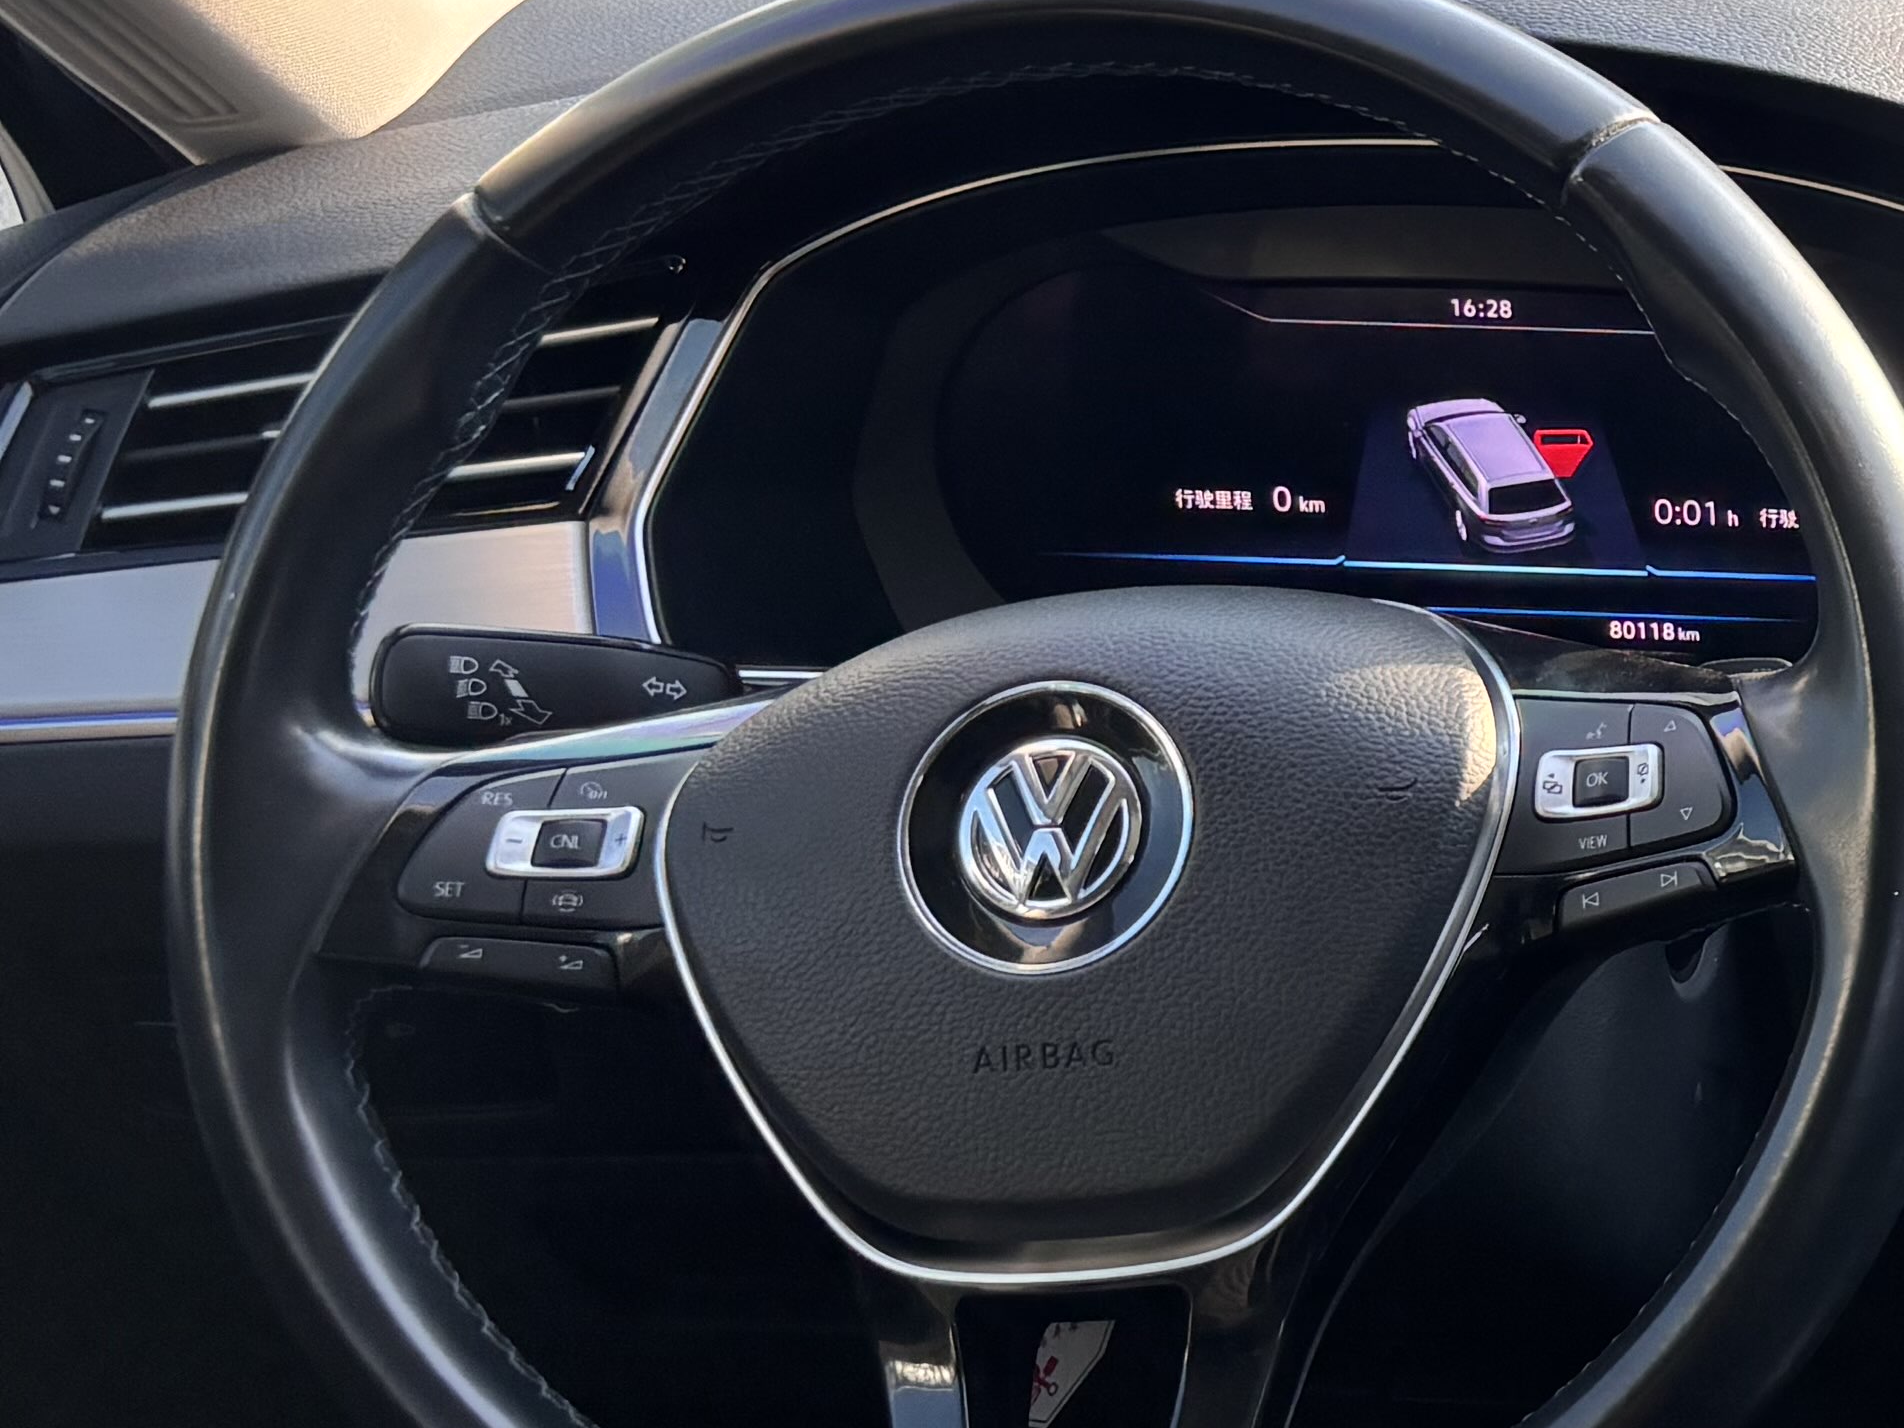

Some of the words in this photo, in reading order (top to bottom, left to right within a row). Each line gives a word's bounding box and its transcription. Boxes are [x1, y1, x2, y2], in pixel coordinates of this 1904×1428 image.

[1450, 298, 1513, 319] 16:28
[1175, 488, 1254, 512] 行驶里程
[1271, 485, 1292, 513] 0
[1299, 495, 1326, 514] km
[1653, 498, 1716, 527] 0:01
[1727, 509, 1740, 528] h
[1608, 620, 1675, 641] 80118
[1677, 627, 1701, 642] km
[1585, 771, 1609, 788] OK
[481, 791, 514, 806] RES
[550, 833, 581, 850] CNL
[1578, 834, 1608, 850] VIEW
[433, 880, 465, 899] SET
[972, 1039, 1116, 1074] AIRBAG
